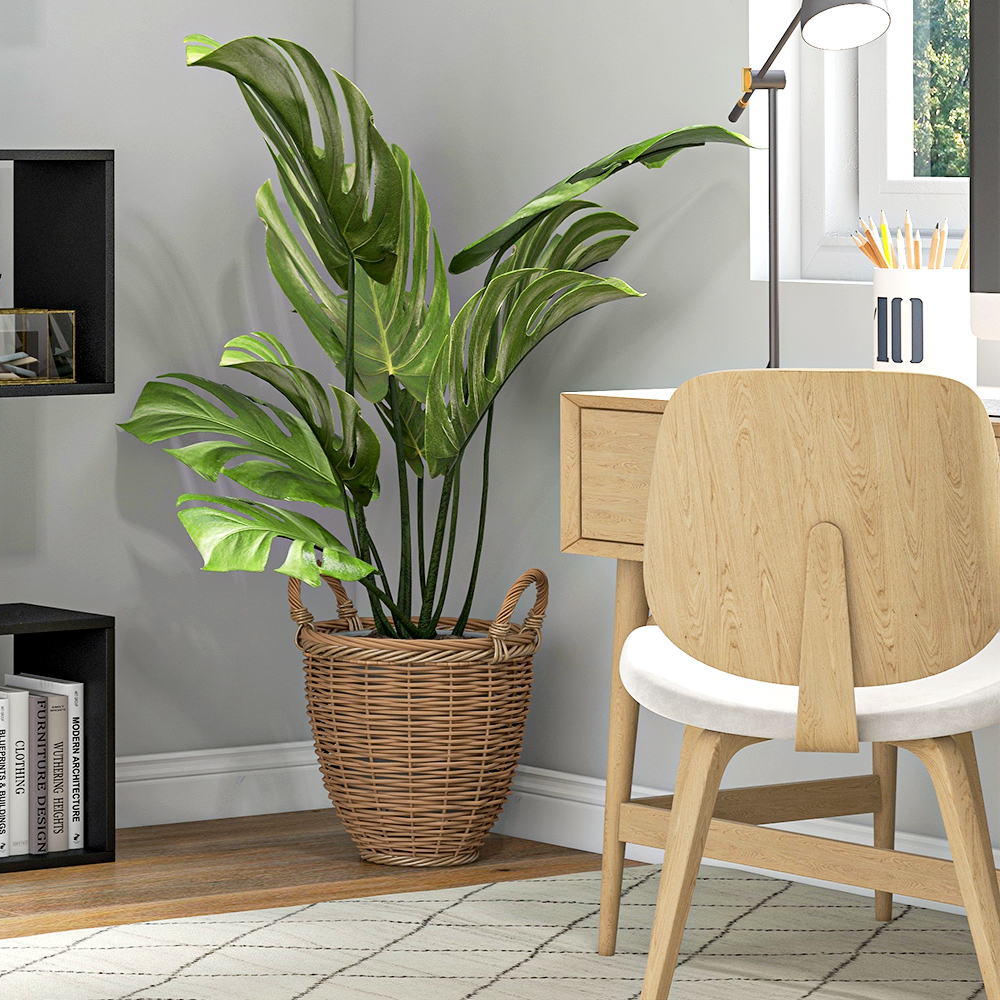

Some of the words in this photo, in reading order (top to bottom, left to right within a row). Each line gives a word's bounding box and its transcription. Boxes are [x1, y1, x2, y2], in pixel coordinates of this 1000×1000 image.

[37, 700, 46, 791] FURNITURE
[72, 716, 80, 755] MODERN
[15, 740, 25, 795] CLOTHING
[53, 741, 64, 794] WUTHERING
[72, 756, 80, 822] ARCHITECTURE
[37, 796, 46, 852] DESIGN
[53, 797, 64, 834] HEIGHTS
